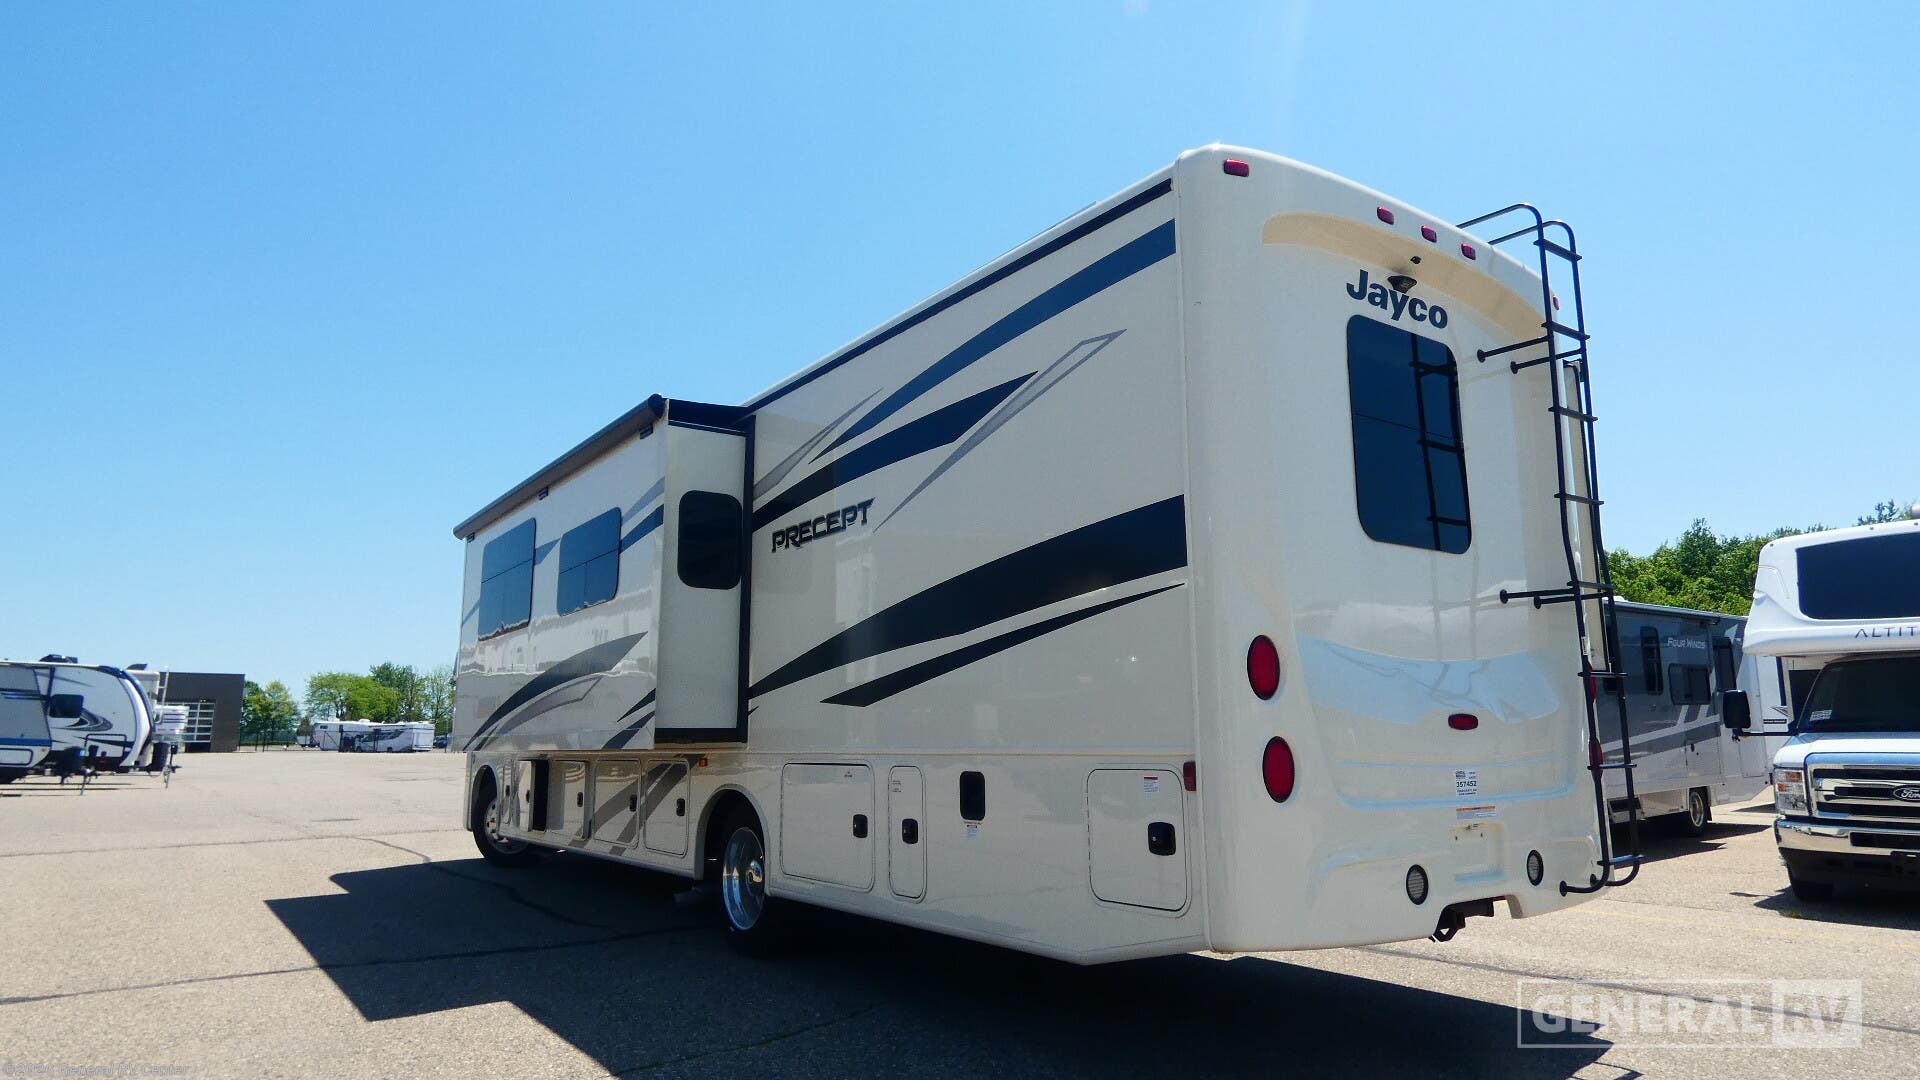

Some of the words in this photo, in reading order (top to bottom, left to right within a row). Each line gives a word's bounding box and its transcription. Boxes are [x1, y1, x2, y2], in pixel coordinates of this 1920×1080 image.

[1346, 269, 1448, 329] Jayco
[771, 497, 876, 553] PRECEPT
[1456, 780, 1477, 788] 357452
[1901, 788, 1920, 798] For
